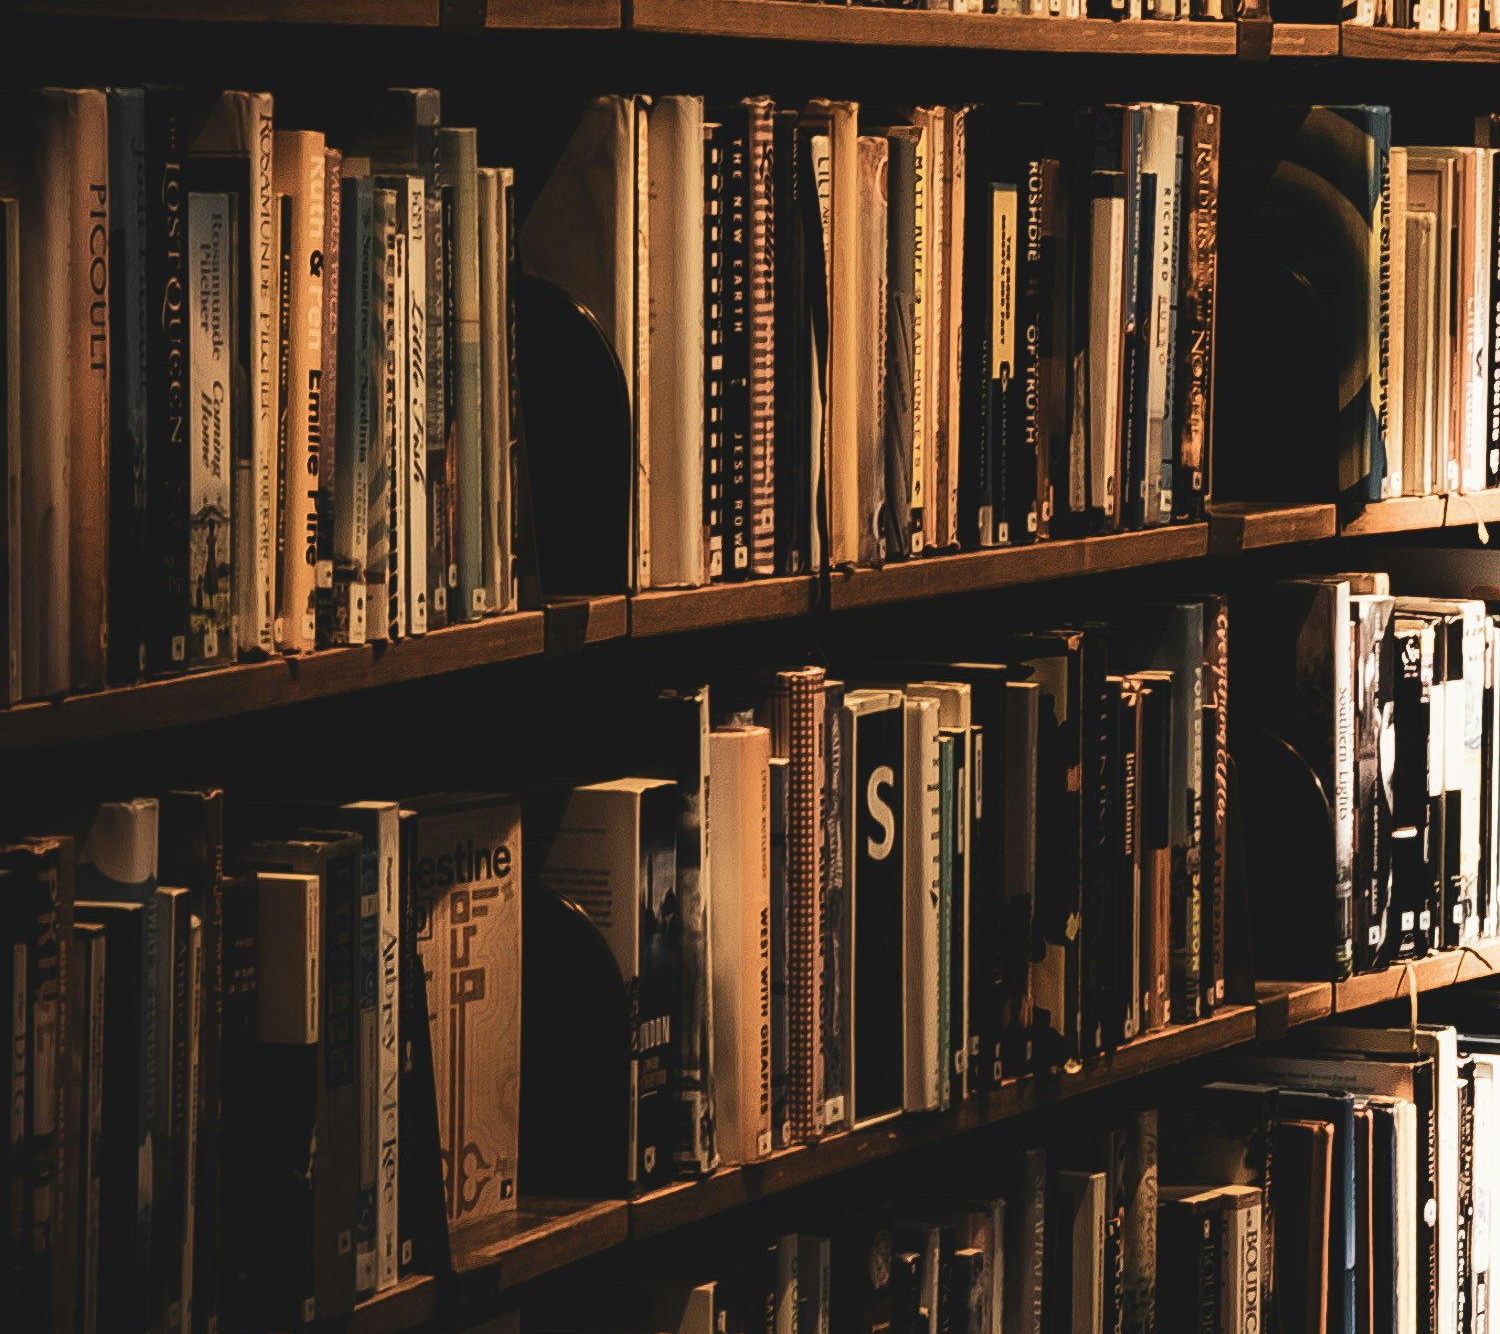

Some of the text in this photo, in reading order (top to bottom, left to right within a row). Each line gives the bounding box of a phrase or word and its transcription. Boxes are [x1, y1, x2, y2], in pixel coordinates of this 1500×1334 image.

[160, 161, 182, 260] LOST
[260, 112, 272, 299] ROSAMUNDE
[309, 155, 324, 237] Ruth
[914, 155, 923, 211] MATT
[1026, 160, 1039, 262] RUSHDIE
[90, 184, 106, 379] PICOULT
[309, 249, 324, 277] &
[732, 138, 742, 334] THE NEW EARTH
[1160, 186, 1170, 283] RICHARD
[200, 241, 210, 332] Pilcher
[210, 212, 223, 361] Rosamunde
[160, 276, 182, 444] QUEEN
[411, 291, 424, 386] Little
[1025, 324, 1035, 444] OF TRUTH
[200, 390, 212, 469] Home
[210, 380, 224, 479] Coming
[306, 369, 320, 567] Emilie Pine
[733, 432, 742, 547] JESS ROW
[1335, 685, 1348, 821] Southern Lights
[866, 765, 895, 861] S
[1124, 751, 1134, 857] Belladonna
[414, 840, 512, 887] estine
[1192, 873, 1200, 972] SAMSON
[58, 1002, 66, 1057] PRICE
[176, 940, 186, 1026] Annie
[759, 908, 768, 1115] WEST WITH GIRAFFES
[13, 1034, 26, 1116] DIG
[380, 927, 397, 1205] Aubrey McKee
[1033, 1218, 1042, 1282] WHAT
